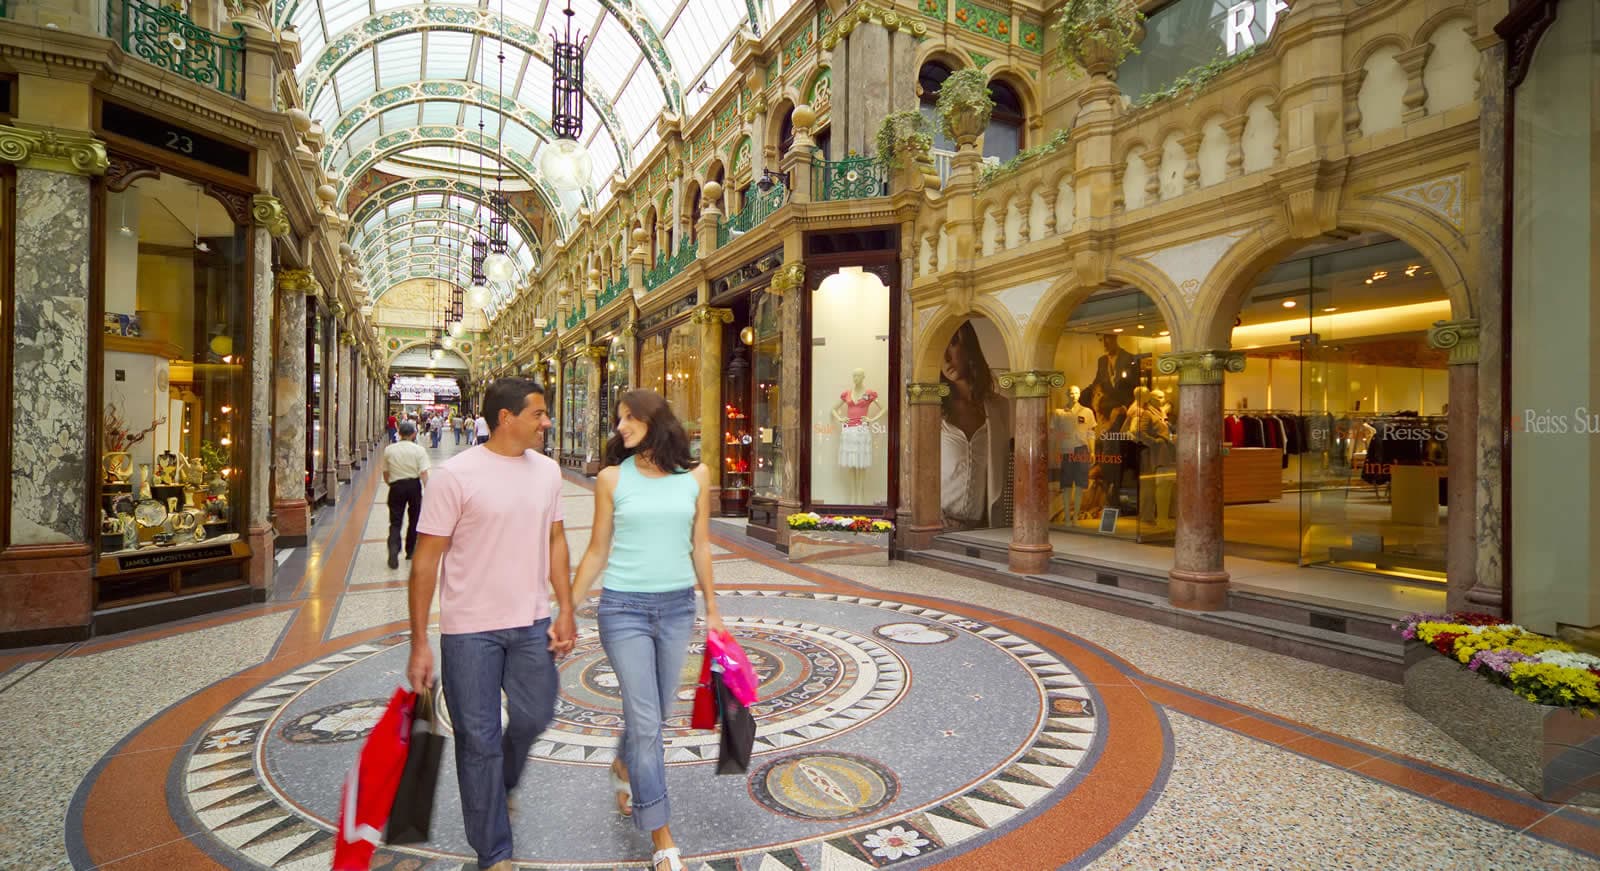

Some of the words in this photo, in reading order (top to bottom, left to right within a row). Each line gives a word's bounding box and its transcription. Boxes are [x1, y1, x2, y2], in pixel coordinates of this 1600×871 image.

[166, 131, 193, 153] 23
[1523, 408, 1568, 433] Reiss
[1311, 427, 1329, 440] er
[1382, 424, 1432, 441] Reiss
